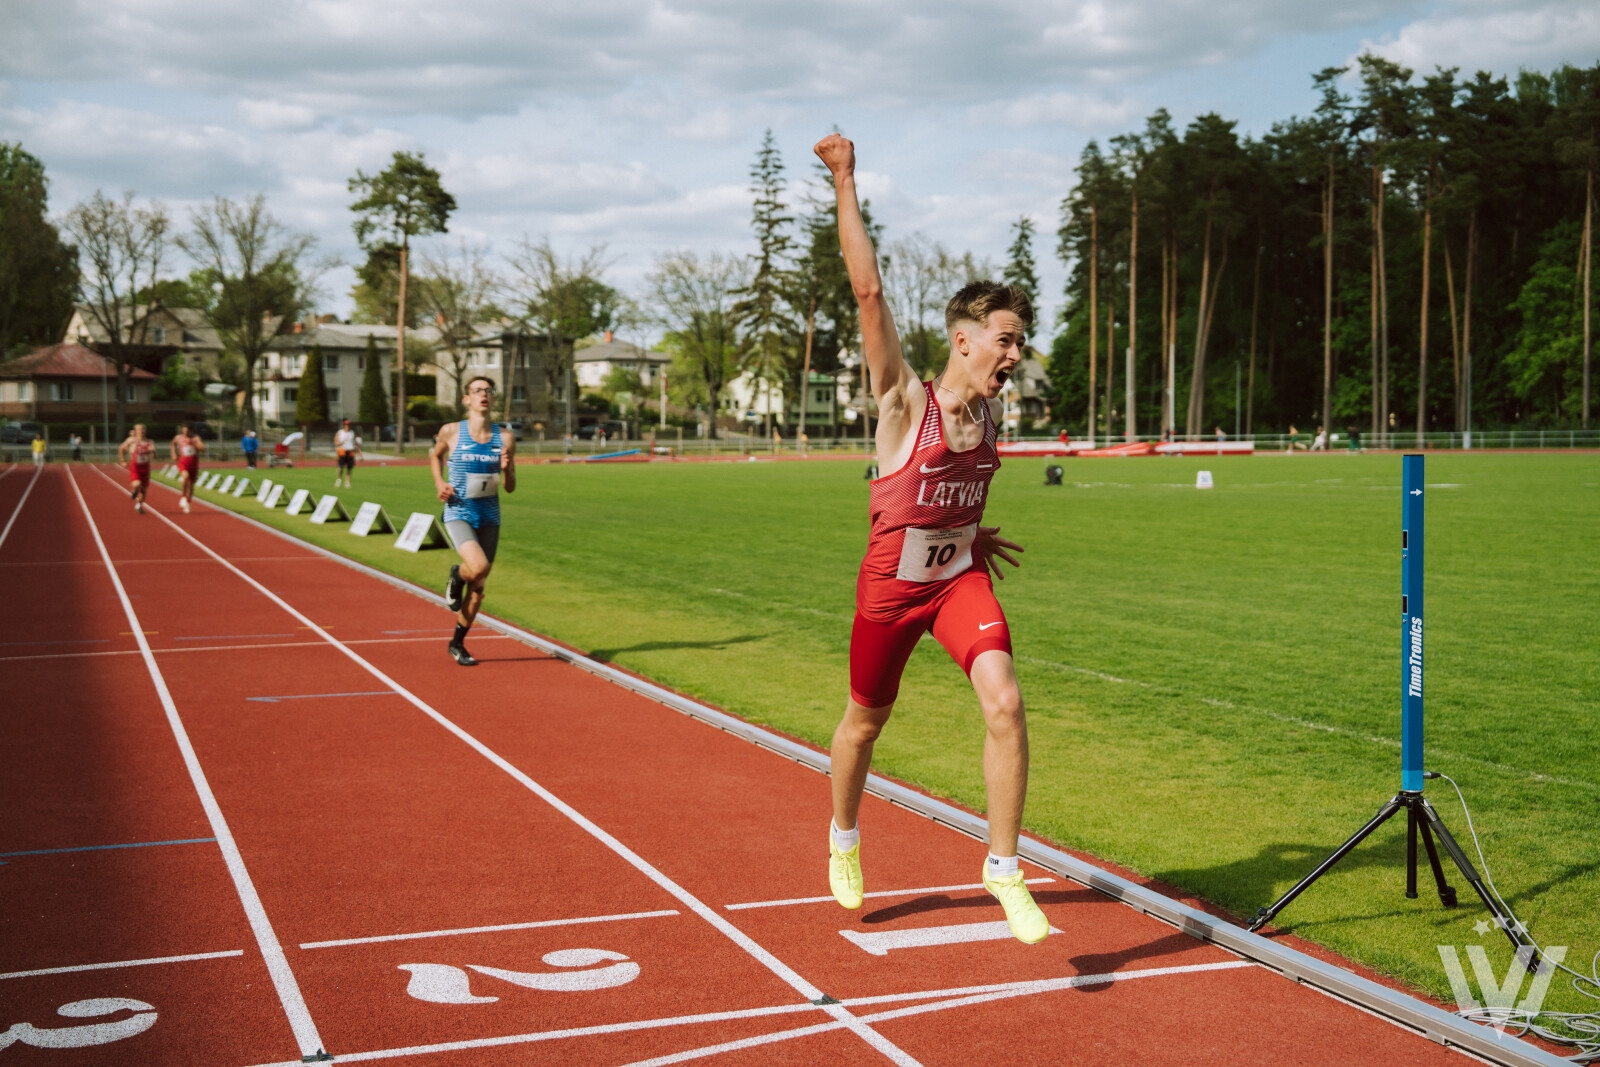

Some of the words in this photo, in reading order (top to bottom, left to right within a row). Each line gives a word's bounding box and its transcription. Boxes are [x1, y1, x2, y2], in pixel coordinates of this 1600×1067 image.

[481, 481, 488, 491] 1
[917, 480, 985, 507] LATVIA
[925, 543, 957, 568] 10
[1408, 616, 1423, 698] TimeTronics
[397, 947, 641, 1005] 2
